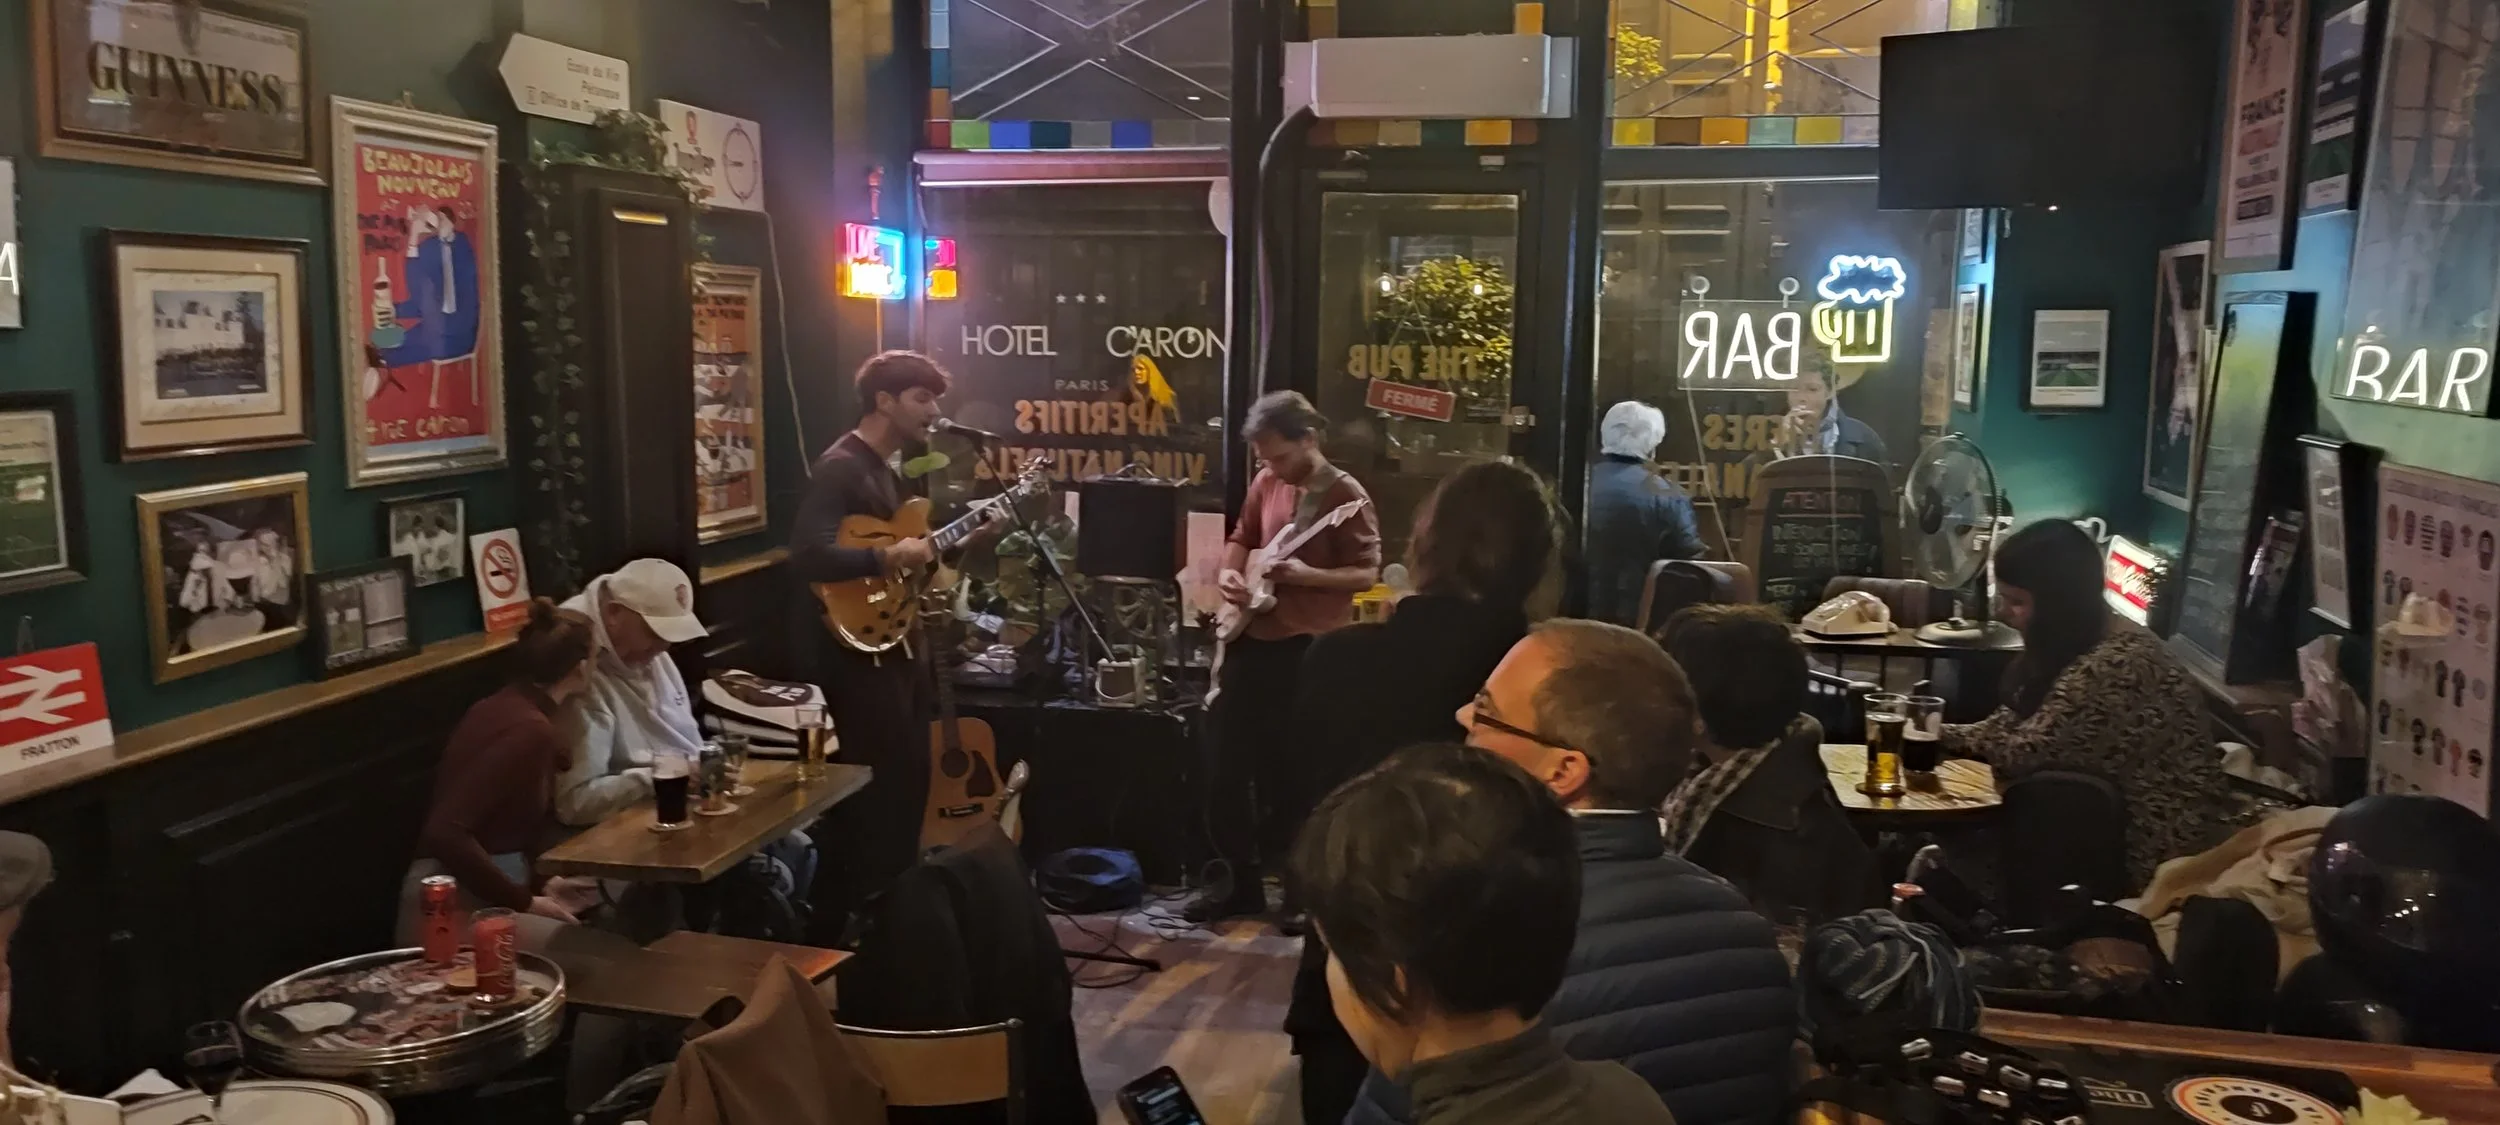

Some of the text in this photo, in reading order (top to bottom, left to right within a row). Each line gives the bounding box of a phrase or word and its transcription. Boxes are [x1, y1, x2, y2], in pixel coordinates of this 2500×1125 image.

[87, 40, 283, 115] GUINNESS
[361, 146, 473, 185] BEAUJOLAIS
[376, 174, 460, 200] NOUVEAU
[961, 325, 1226, 359] HOTEL CARON
[1054, 379, 1110, 392] PARIS
[2346, 345, 2489, 412] BAR
[20, 734, 82, 761] FRATTON
